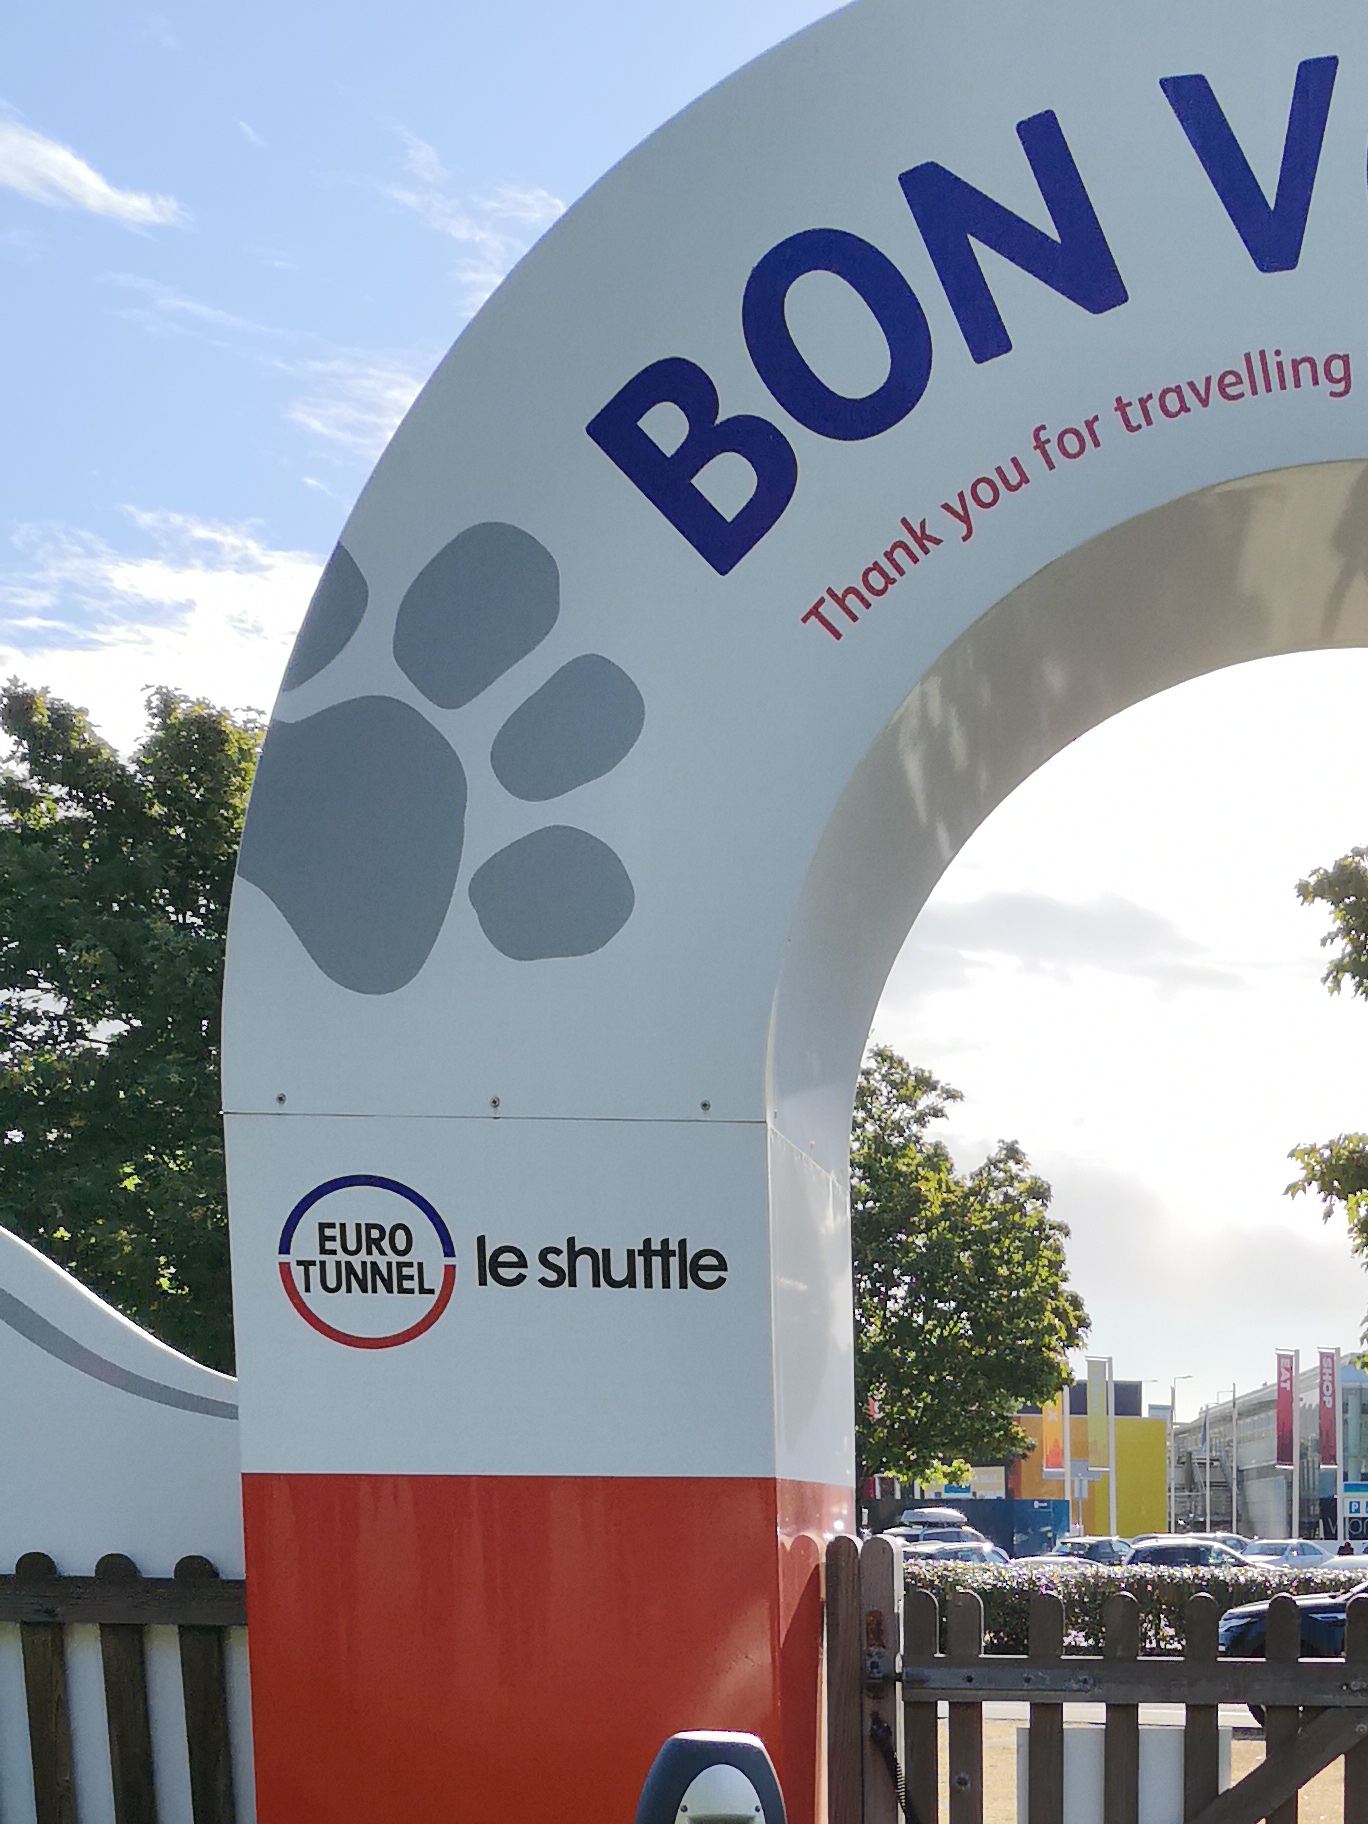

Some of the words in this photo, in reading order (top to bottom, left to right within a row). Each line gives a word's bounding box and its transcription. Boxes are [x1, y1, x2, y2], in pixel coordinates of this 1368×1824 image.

[585, 110, 1129, 576] BON
[801, 518, 942, 643] Thank
[940, 457, 1030, 543] you
[1032, 416, 1102, 471] for
[1114, 349, 1352, 434] travelling
[317, 1221, 414, 1257] EURO
[475, 1234, 530, 1288] le
[537, 1236, 729, 1291] shuttle
[295, 1259, 436, 1296] TUNNEL
[1280, 1358, 1291, 1392] EAT
[1321, 1357, 1333, 1409] SHOP
